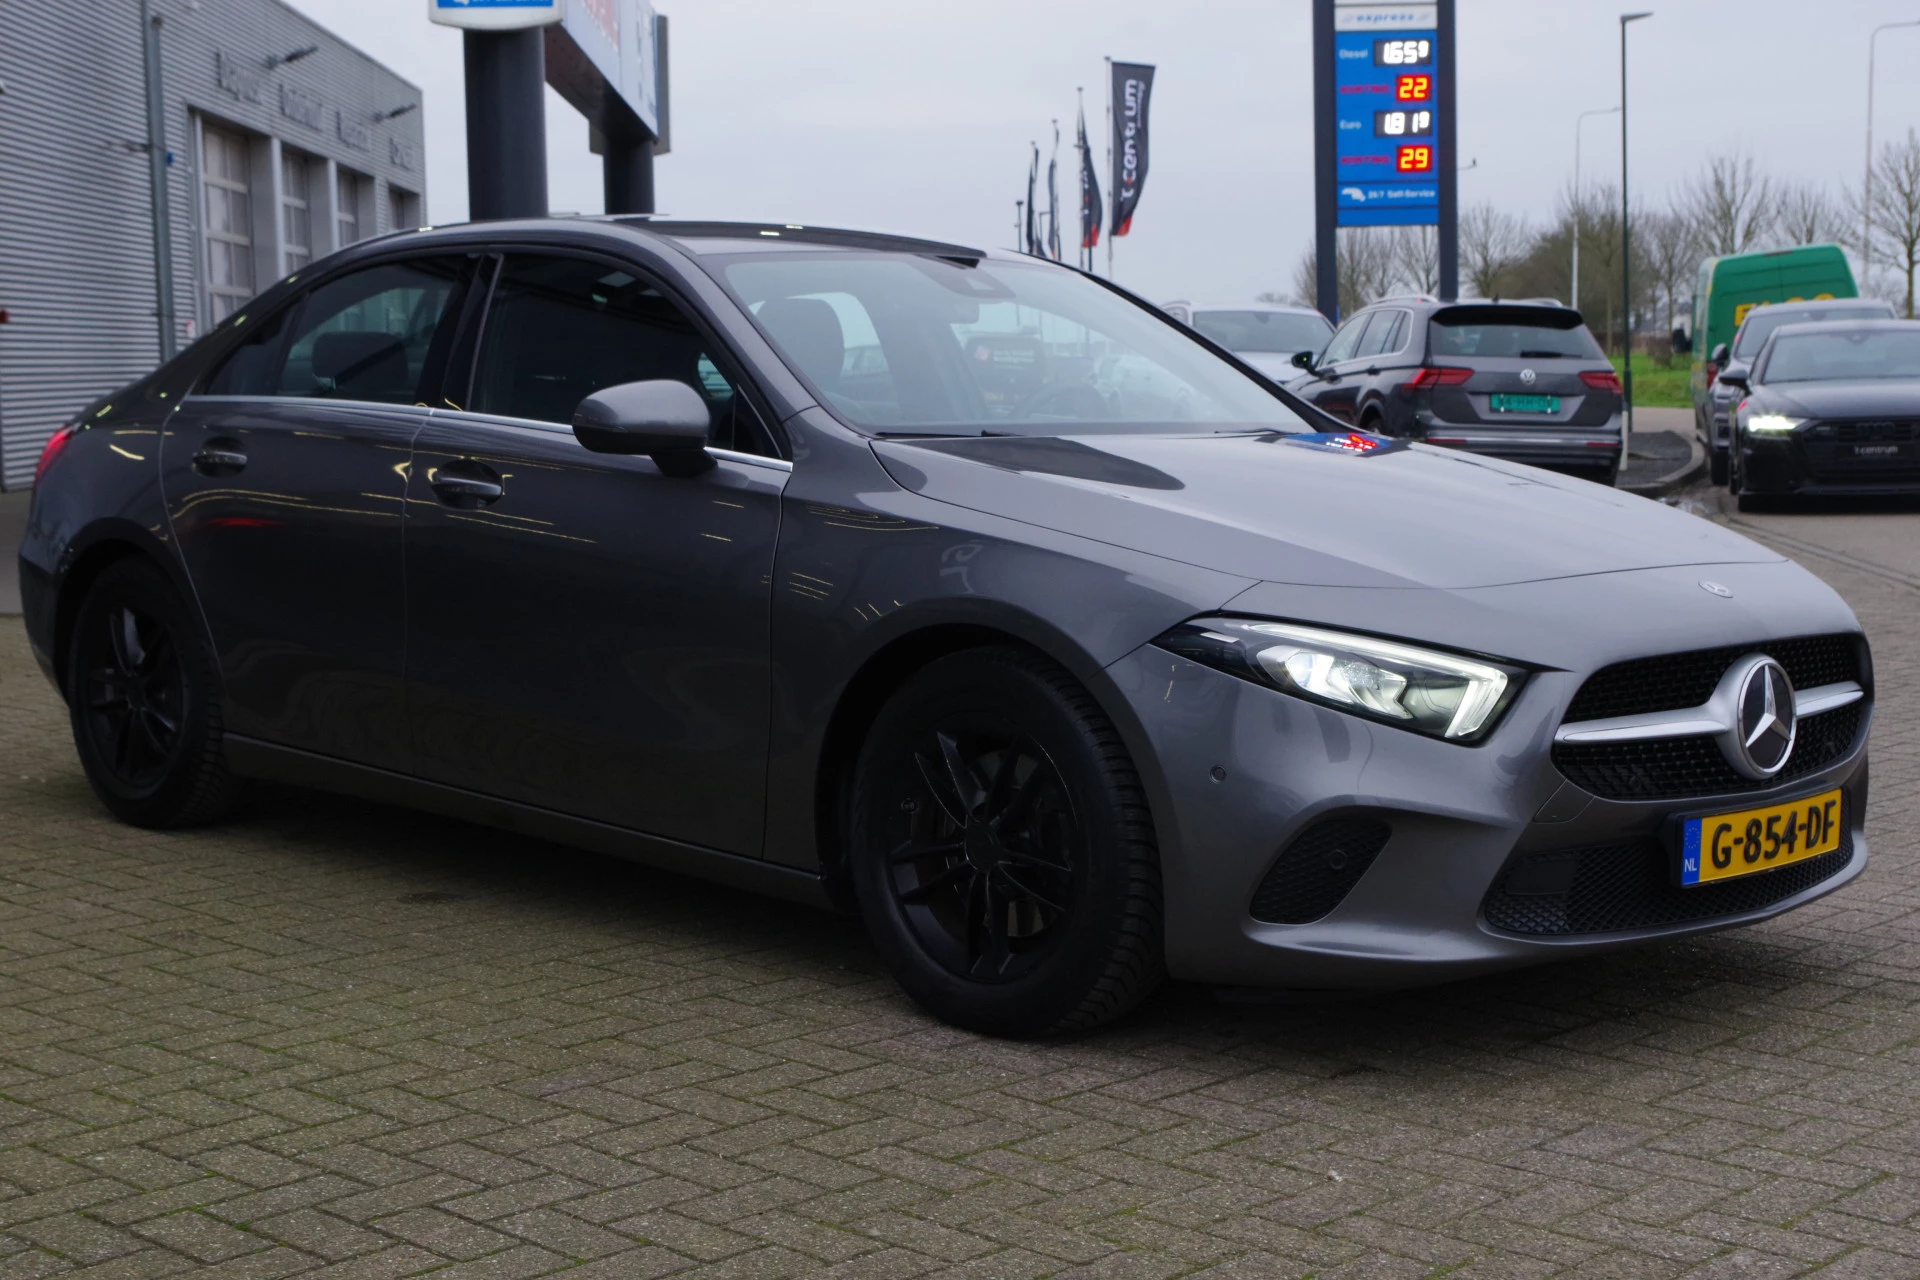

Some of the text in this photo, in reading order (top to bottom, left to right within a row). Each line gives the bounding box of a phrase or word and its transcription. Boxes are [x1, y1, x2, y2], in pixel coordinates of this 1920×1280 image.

[1356, 13, 1415, 23] express
[1399, 77, 1429, 99] 22
[1339, 119, 1363, 130] Euro
[1400, 147, 1429, 169] 29
[1712, 800, 1837, 869] G-854-DF
[1684, 857, 1697, 873] NL
